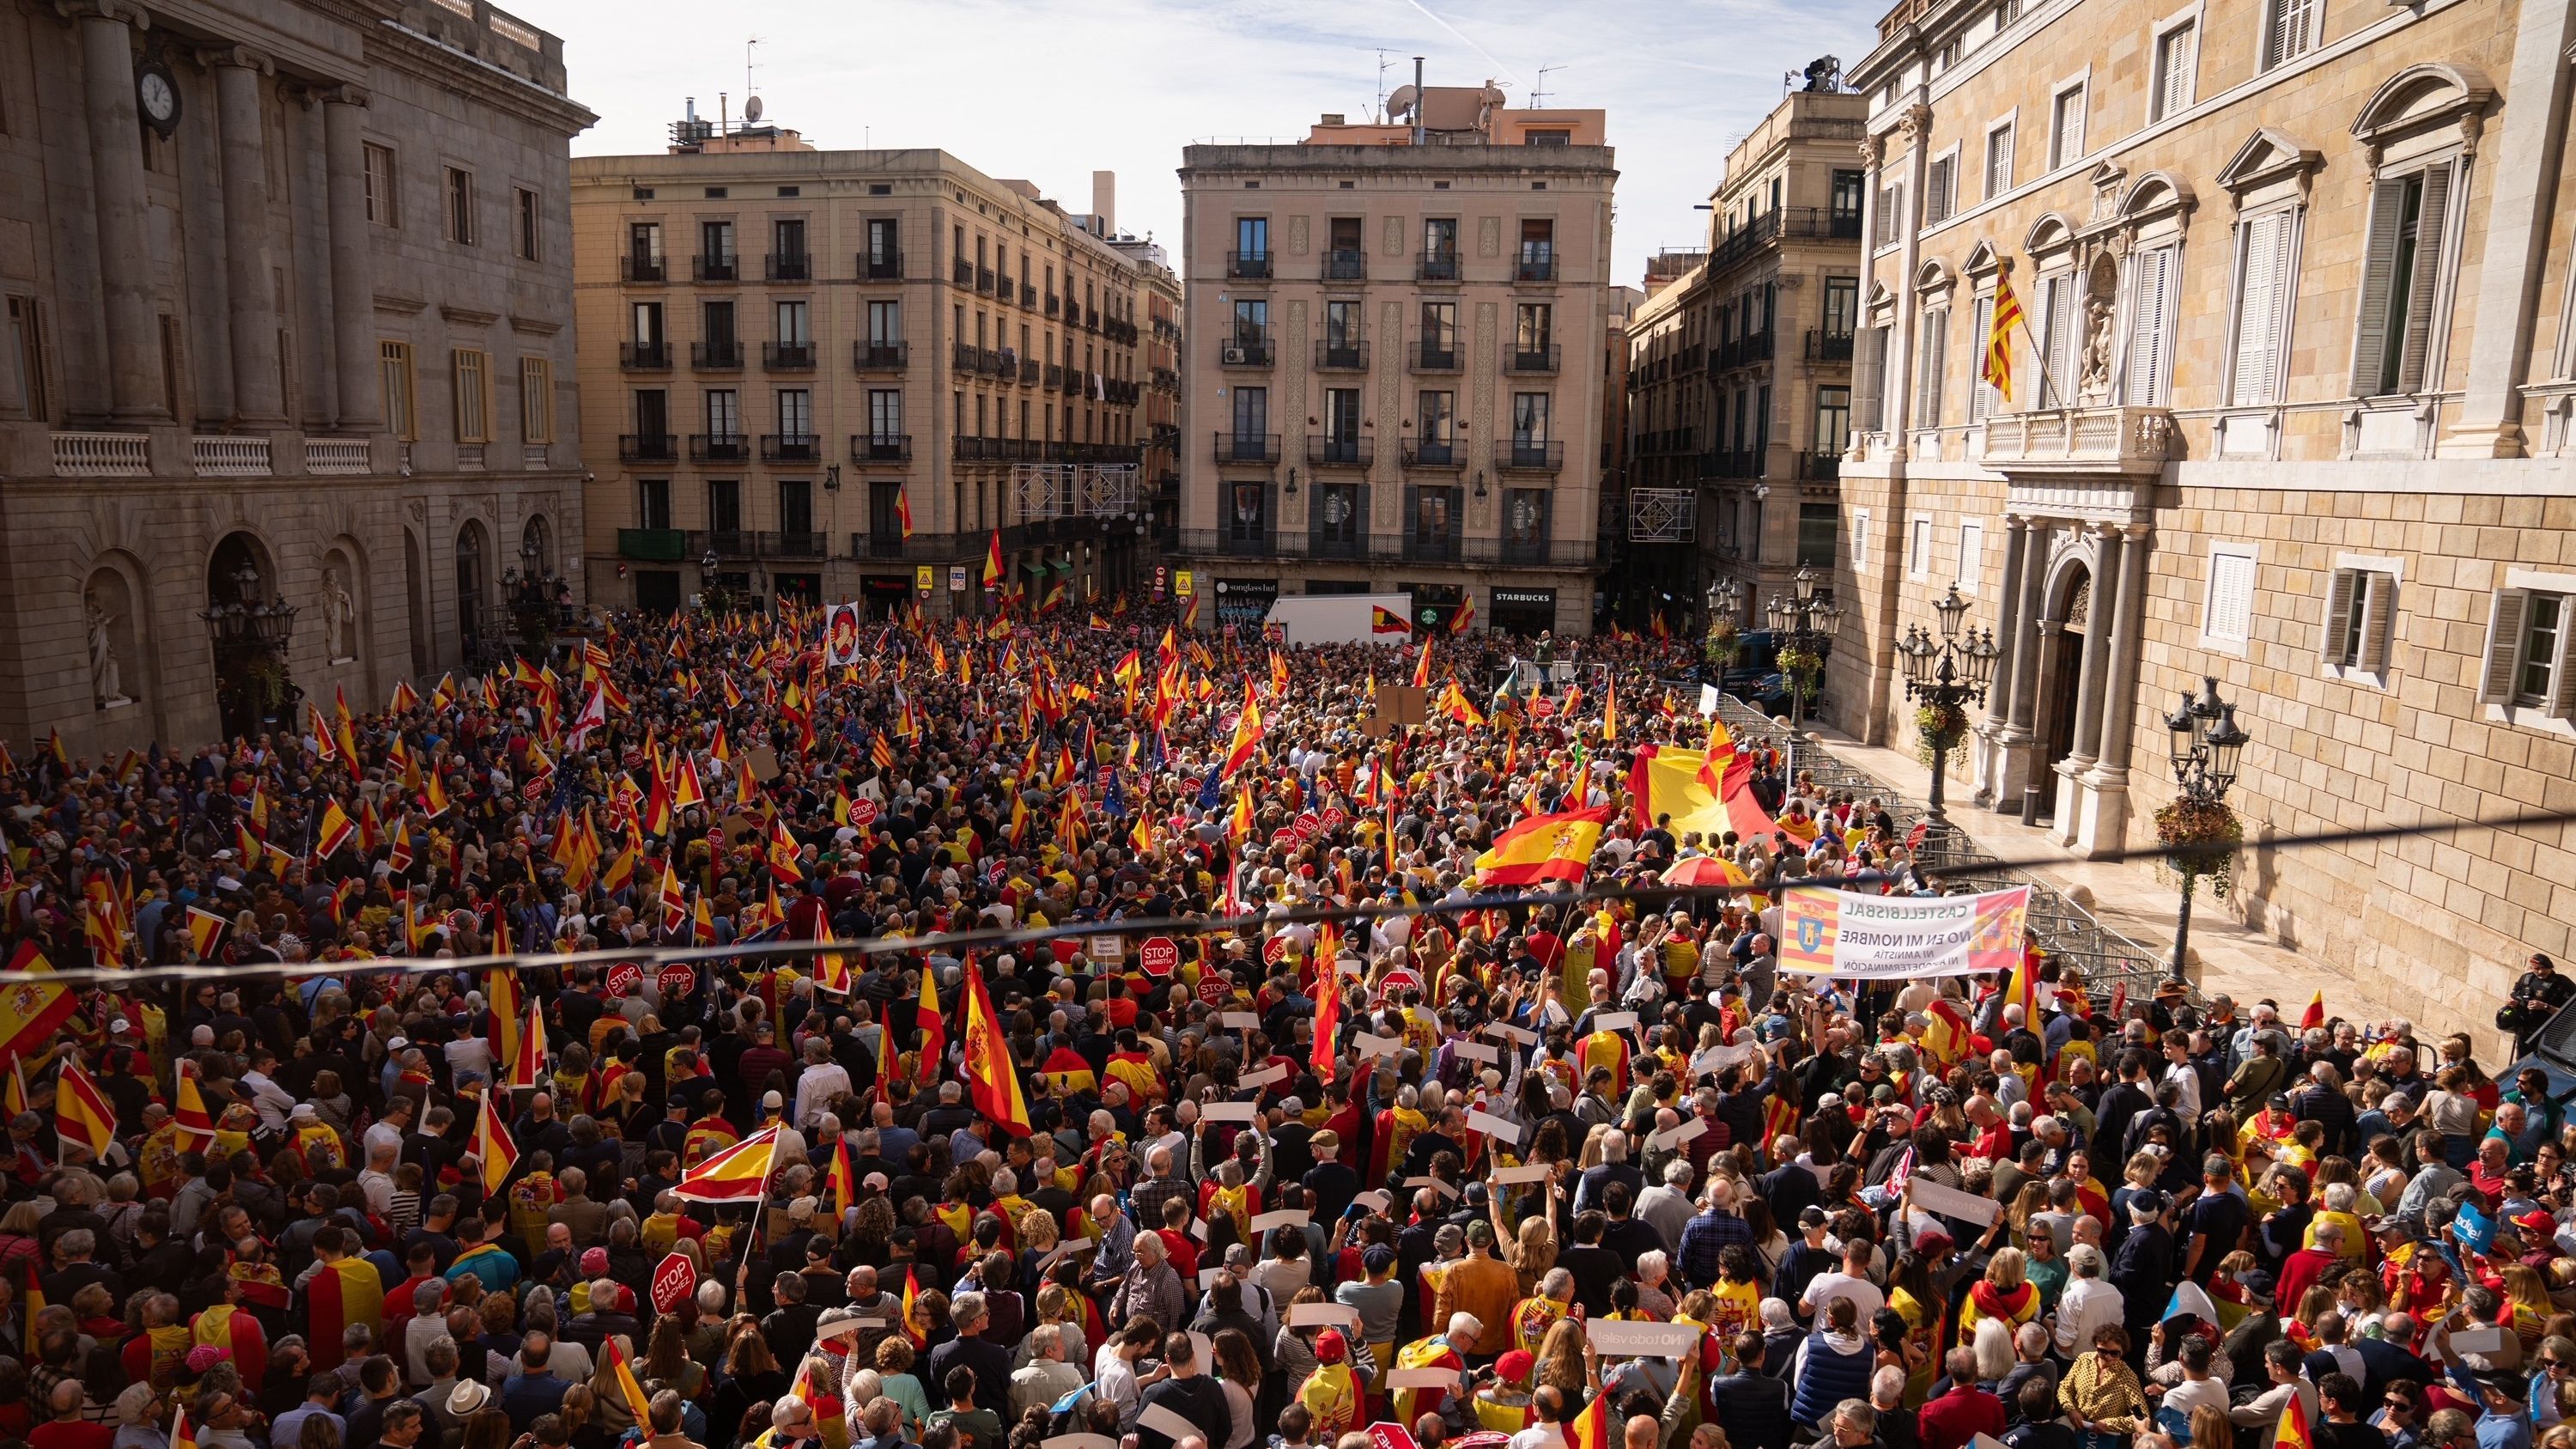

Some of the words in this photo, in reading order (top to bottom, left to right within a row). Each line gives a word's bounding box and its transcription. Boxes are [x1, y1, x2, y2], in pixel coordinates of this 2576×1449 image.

[1229, 583, 1262, 593] sunglass
[1496, 593, 1550, 602] STARBUCKS
[623, 754, 641, 764] STOP
[526, 781, 543, 793] STOP
[1183, 782, 1201, 793] STOP
[852, 802, 872, 816] STOP
[854, 810, 875, 820] AMNISTÍA
[1323, 809, 1336, 828] STOP
[1297, 819, 1318, 831] STOP
[708, 834, 723, 844] STOP
[1910, 830, 1926, 839] STOP
[991, 868, 1006, 881] STO
[1145, 947, 1174, 959] STOP
[610, 966, 636, 989] STOP
[661, 973, 690, 984] STOP
[1200, 983, 1230, 994] STOP
[1383, 982, 1413, 990] STOP
[655, 1261, 686, 1300] STOP
[659, 1275, 691, 1310] SÁNCHEZ
